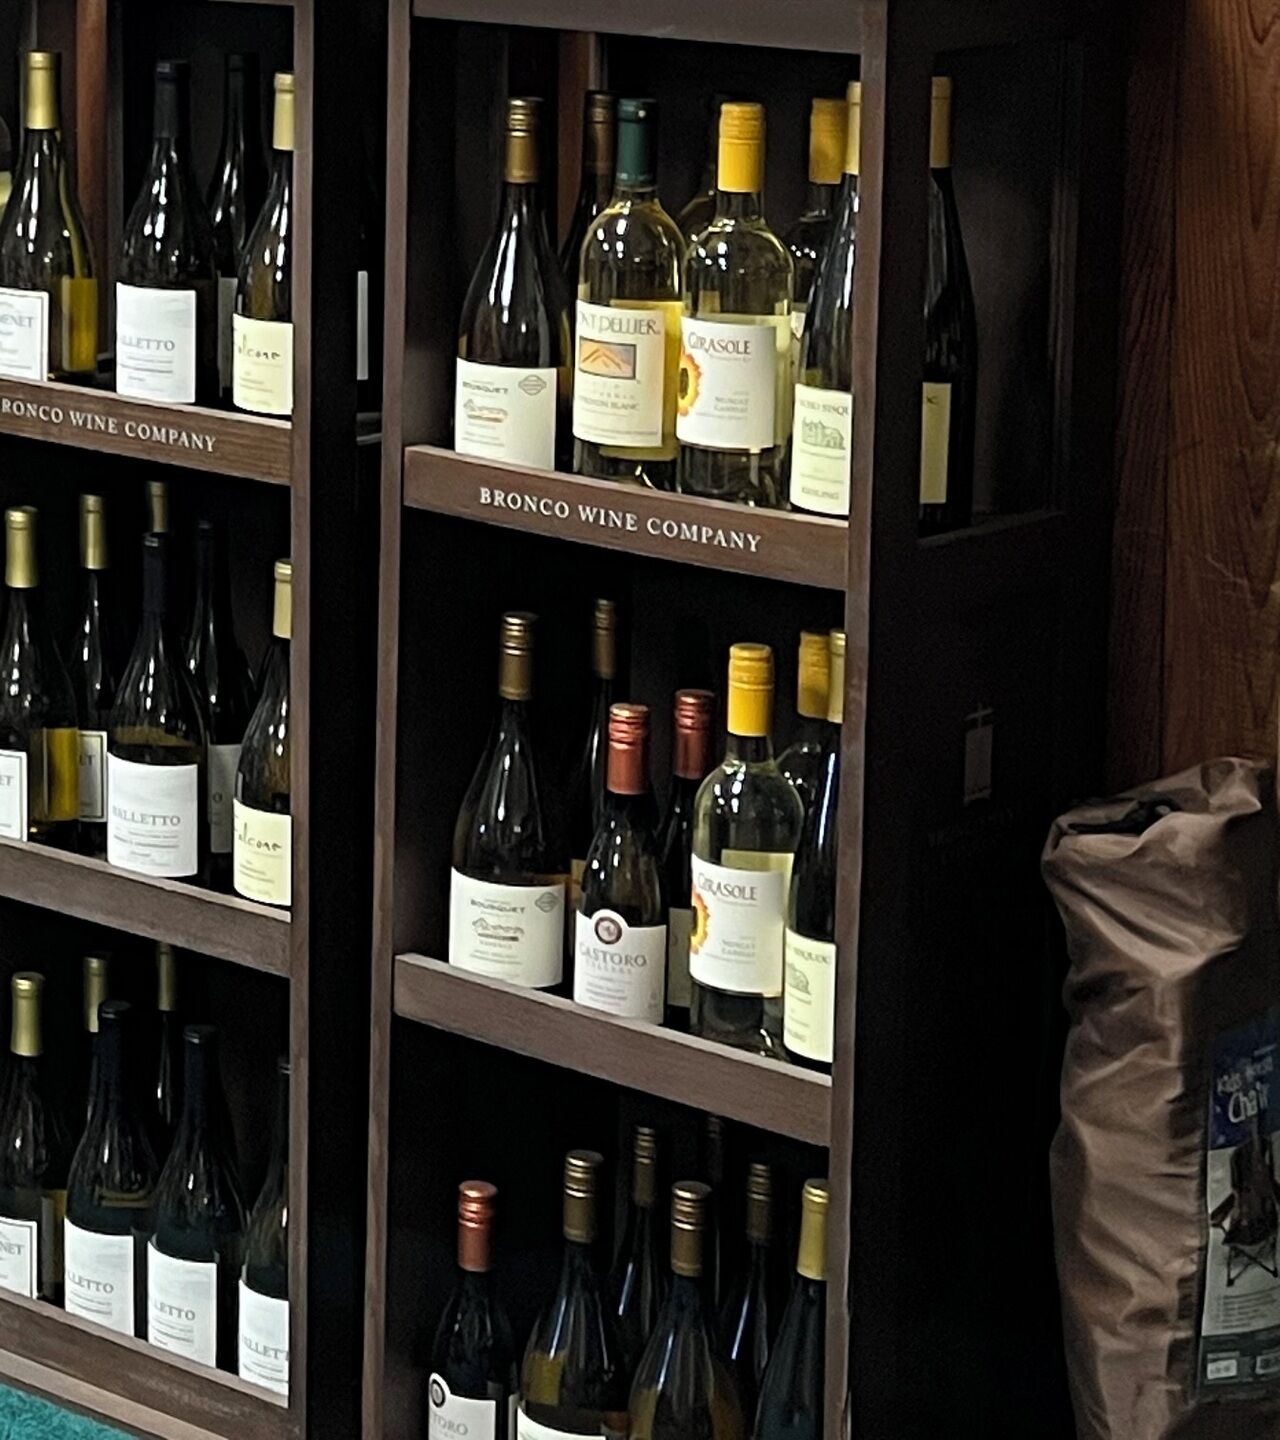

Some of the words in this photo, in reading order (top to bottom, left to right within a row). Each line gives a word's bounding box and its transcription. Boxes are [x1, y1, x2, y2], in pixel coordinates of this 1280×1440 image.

[687, 331, 752, 356] GIRASOLE
[69, 410, 119, 435] WINE
[124, 420, 217, 452] COMPANY
[479, 486, 570, 519] BRONCO
[578, 504, 638, 532] WINE
[646, 517, 761, 553] COMPANY
[697, 872, 758, 901] GIRASOLE
[579, 941, 648, 969] CASTORO
